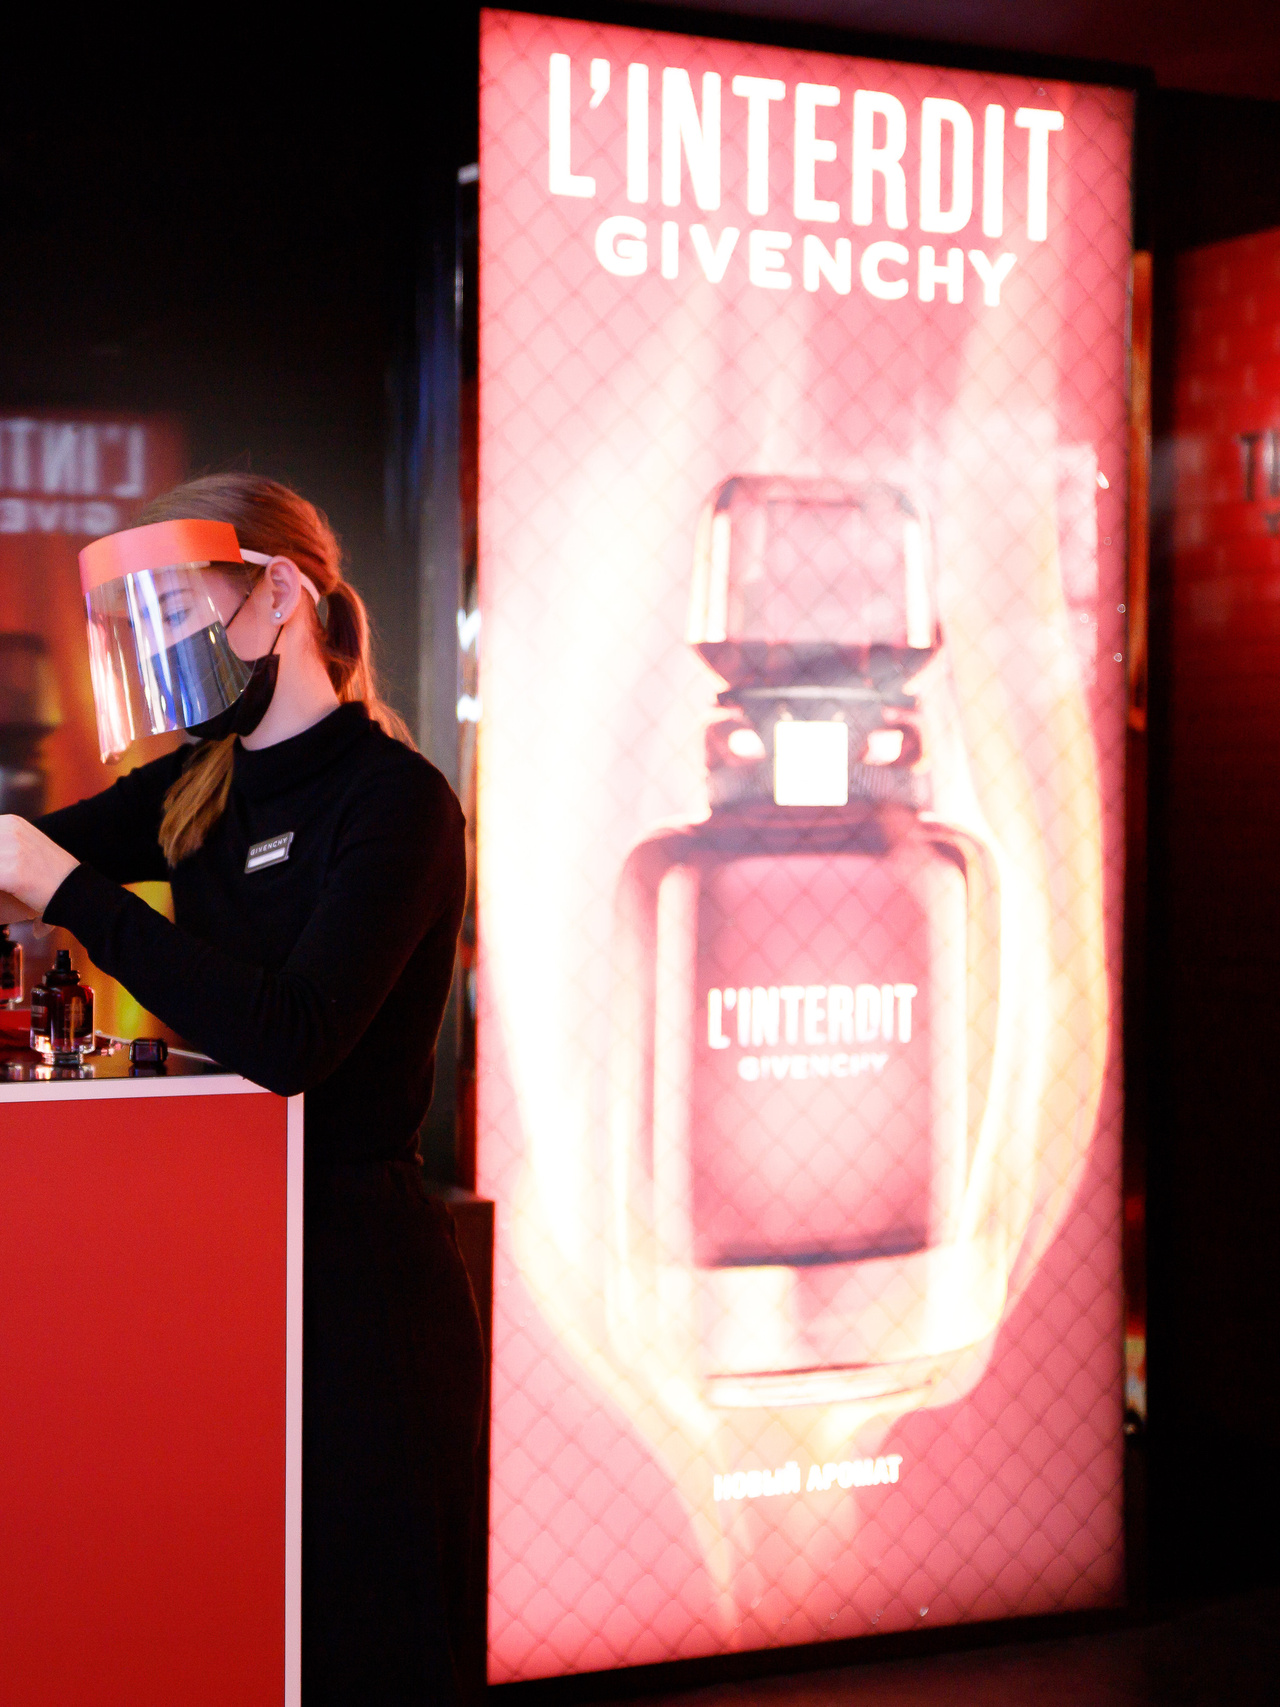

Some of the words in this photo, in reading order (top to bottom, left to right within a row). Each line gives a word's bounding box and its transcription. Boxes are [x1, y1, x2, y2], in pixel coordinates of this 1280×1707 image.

[548, 52, 1065, 242] L'INTERDIT
[594, 215, 1018, 308] GIVENCHY
[250, 837, 287, 856] GIVENCHY
[707, 983, 918, 1050] L'INTERDIT
[737, 1052, 890, 1082] GIVENCHY
[805, 1454, 904, 1493] АРОМАТ
